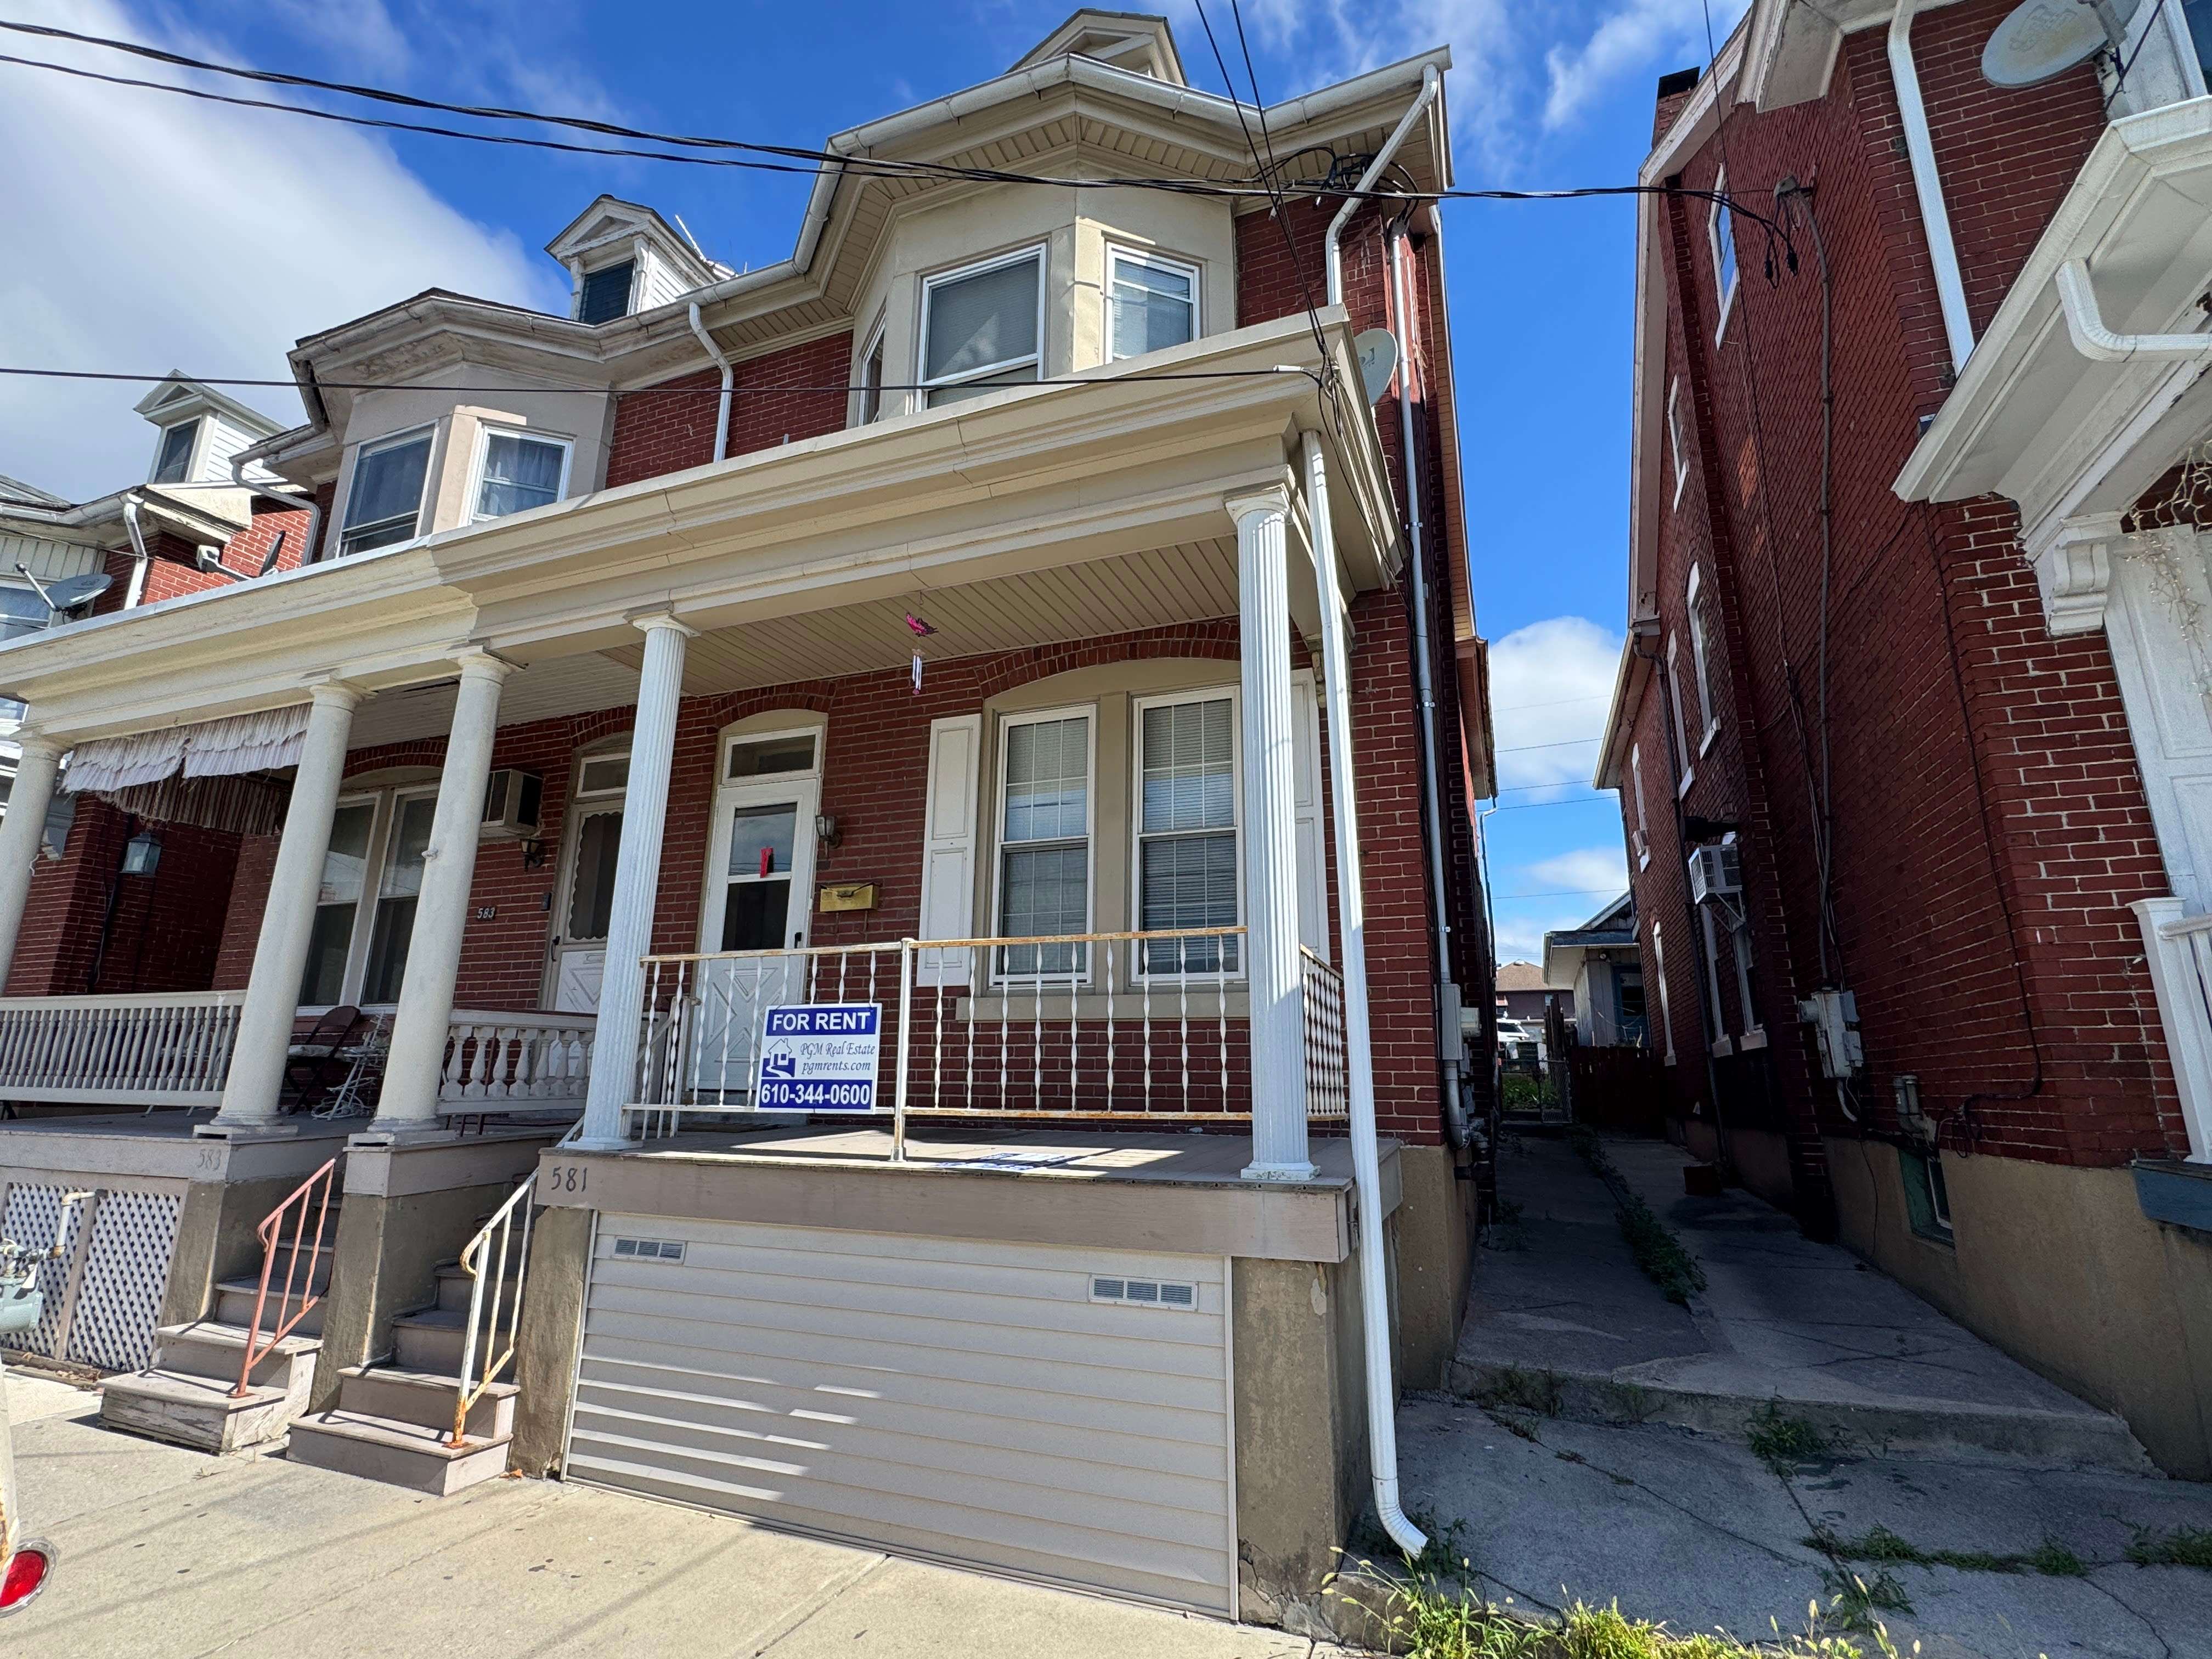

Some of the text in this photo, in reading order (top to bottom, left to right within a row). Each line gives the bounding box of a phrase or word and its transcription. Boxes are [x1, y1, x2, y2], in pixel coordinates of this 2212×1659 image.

[477, 907, 495, 919] 583
[772, 1012, 871, 1031] FOR RENT
[800, 1041, 876, 1059] PGM Real Estate
[802, 1060, 871, 1074] pgmrents.com
[761, 1084, 870, 1104] 610-344-0600
[551, 1166, 588, 1192] 581
